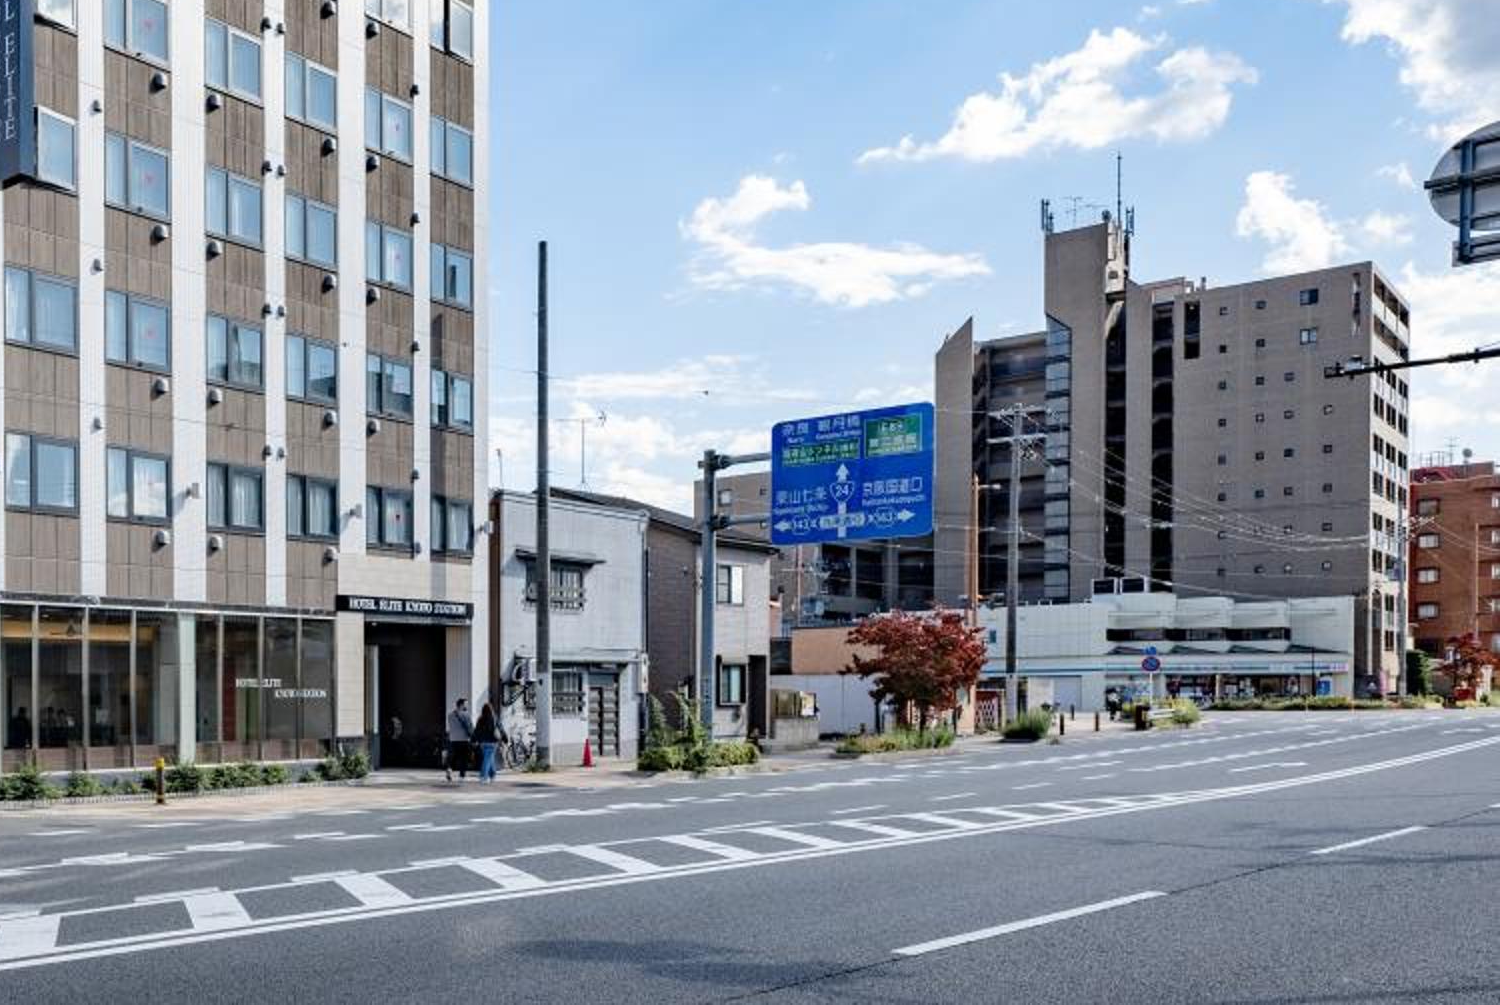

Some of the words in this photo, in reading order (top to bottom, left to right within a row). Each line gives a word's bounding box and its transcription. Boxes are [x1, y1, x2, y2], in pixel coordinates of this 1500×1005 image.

[4, 32, 15, 141] ELITE
[835, 484, 849, 495] 24
[348, 596, 378, 610] HOTEL
[379, 598, 403, 612] ELITE
[405, 600, 433, 614] KYOTO
